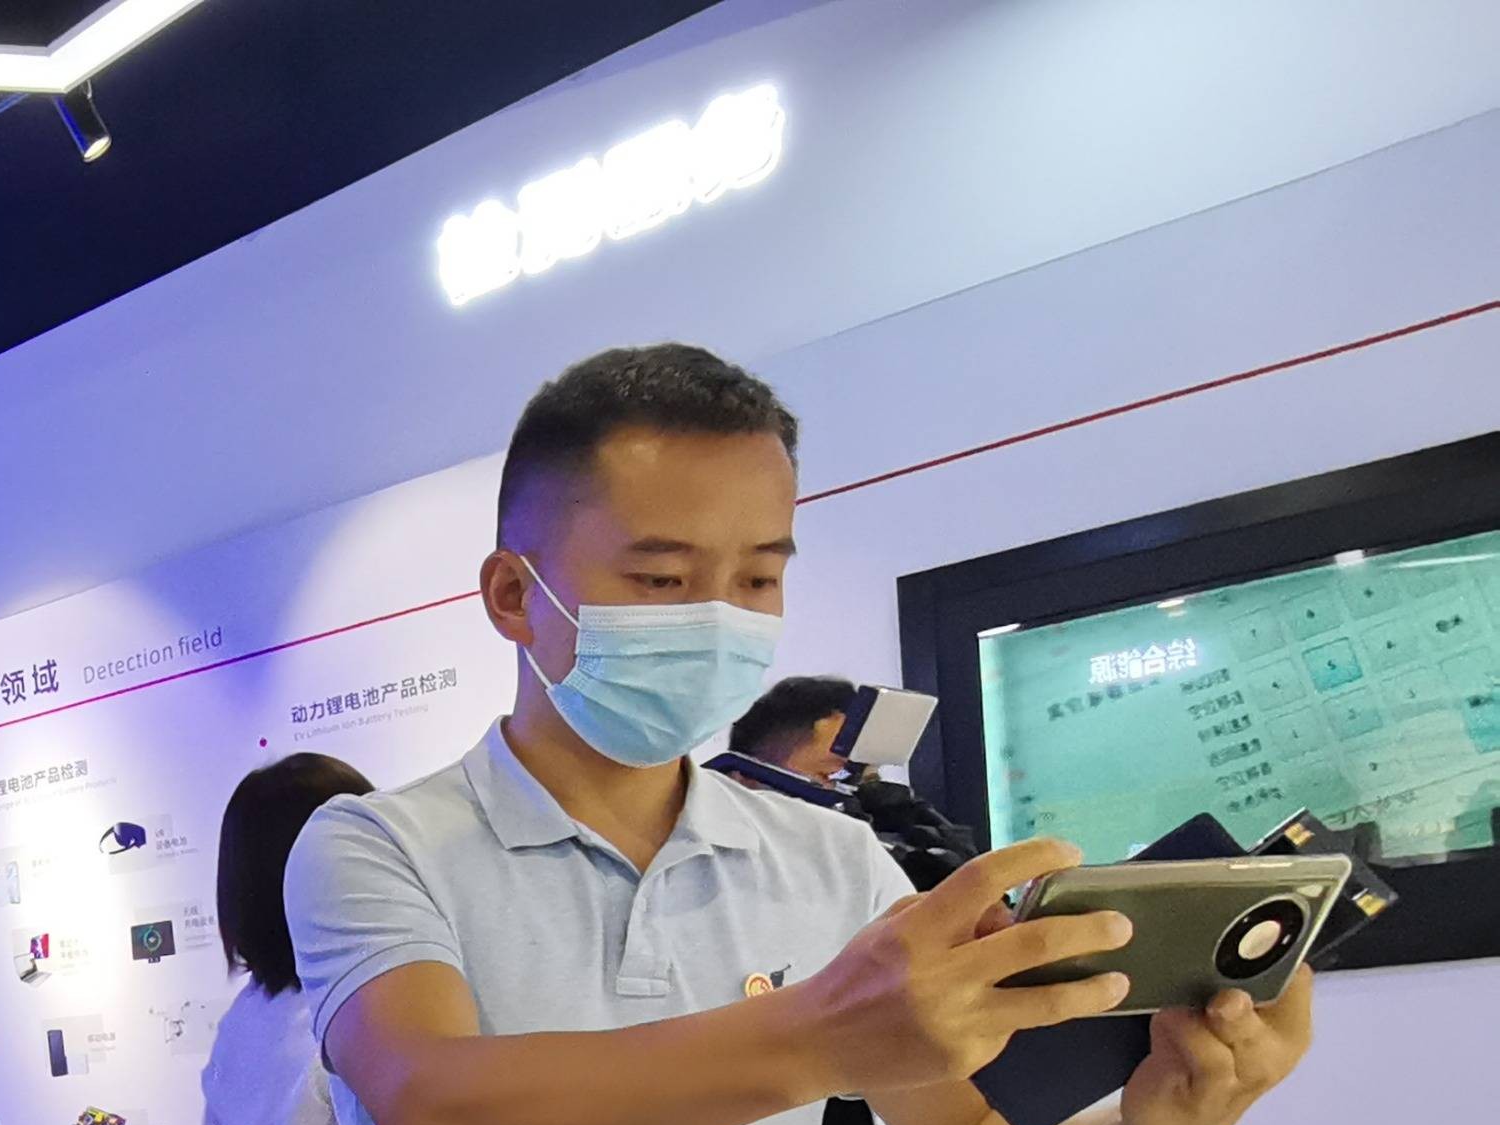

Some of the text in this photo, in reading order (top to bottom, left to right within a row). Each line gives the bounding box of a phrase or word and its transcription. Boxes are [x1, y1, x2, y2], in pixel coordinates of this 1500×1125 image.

[83, 627, 223, 684] Detection field
[291, 667, 458, 724] 动力锂电池产品检测
